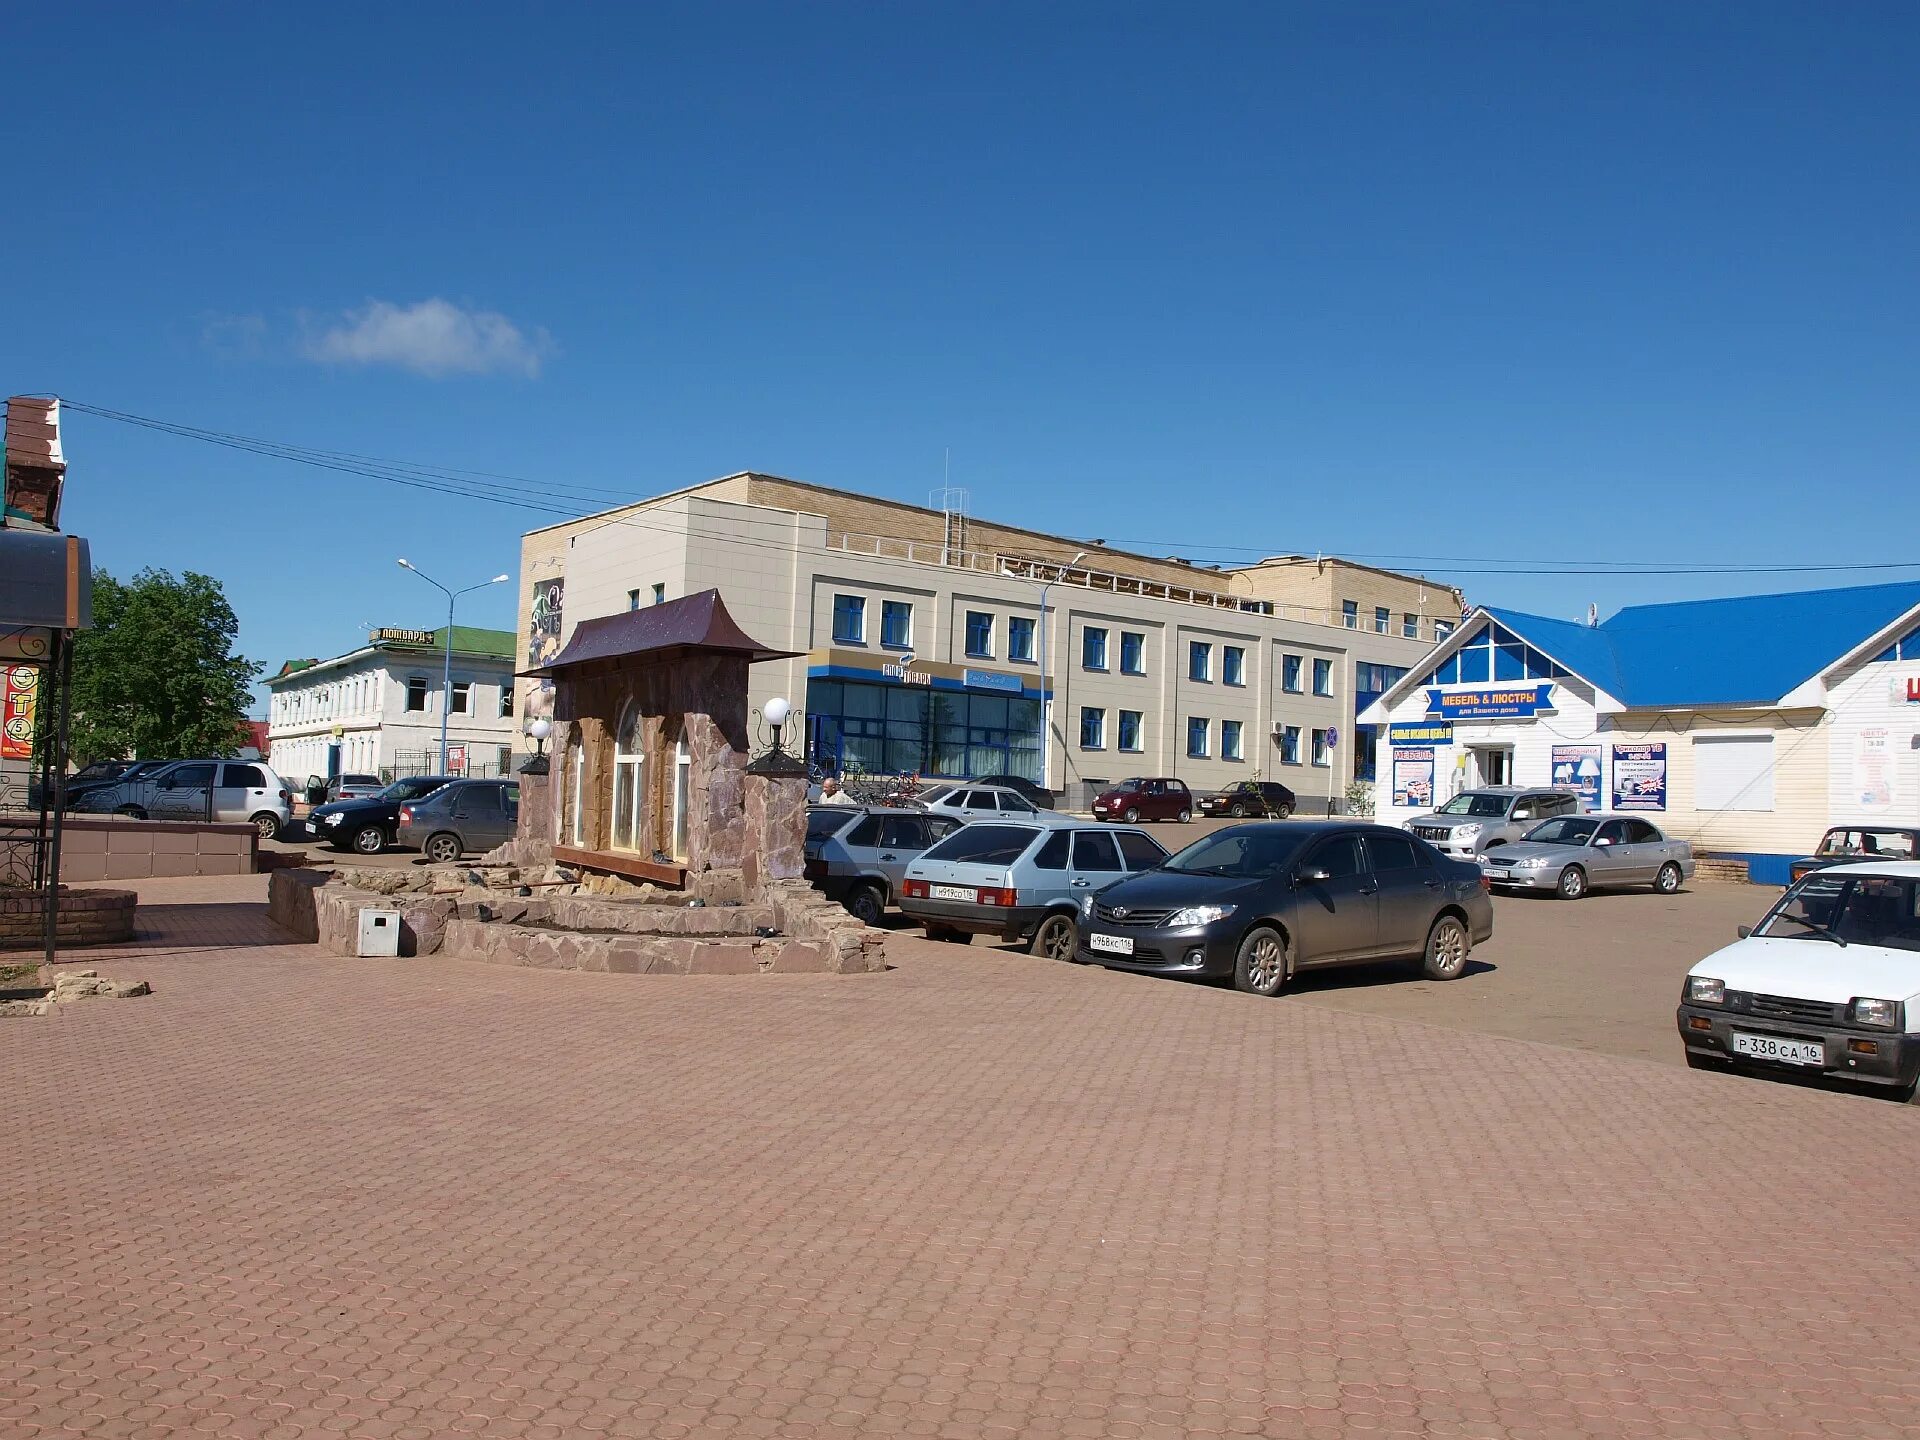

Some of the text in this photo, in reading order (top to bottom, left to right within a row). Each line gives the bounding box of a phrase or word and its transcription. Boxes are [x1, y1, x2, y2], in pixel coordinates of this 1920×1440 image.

[382, 628, 425, 642] ЛОМБАРД
[1442, 692, 1536, 706] МЕБЕЛЬ & ЛЮСТРЫ
[1458, 706, 1519, 716] для Вашего дома
[1615, 744, 1651, 755] Триколор
